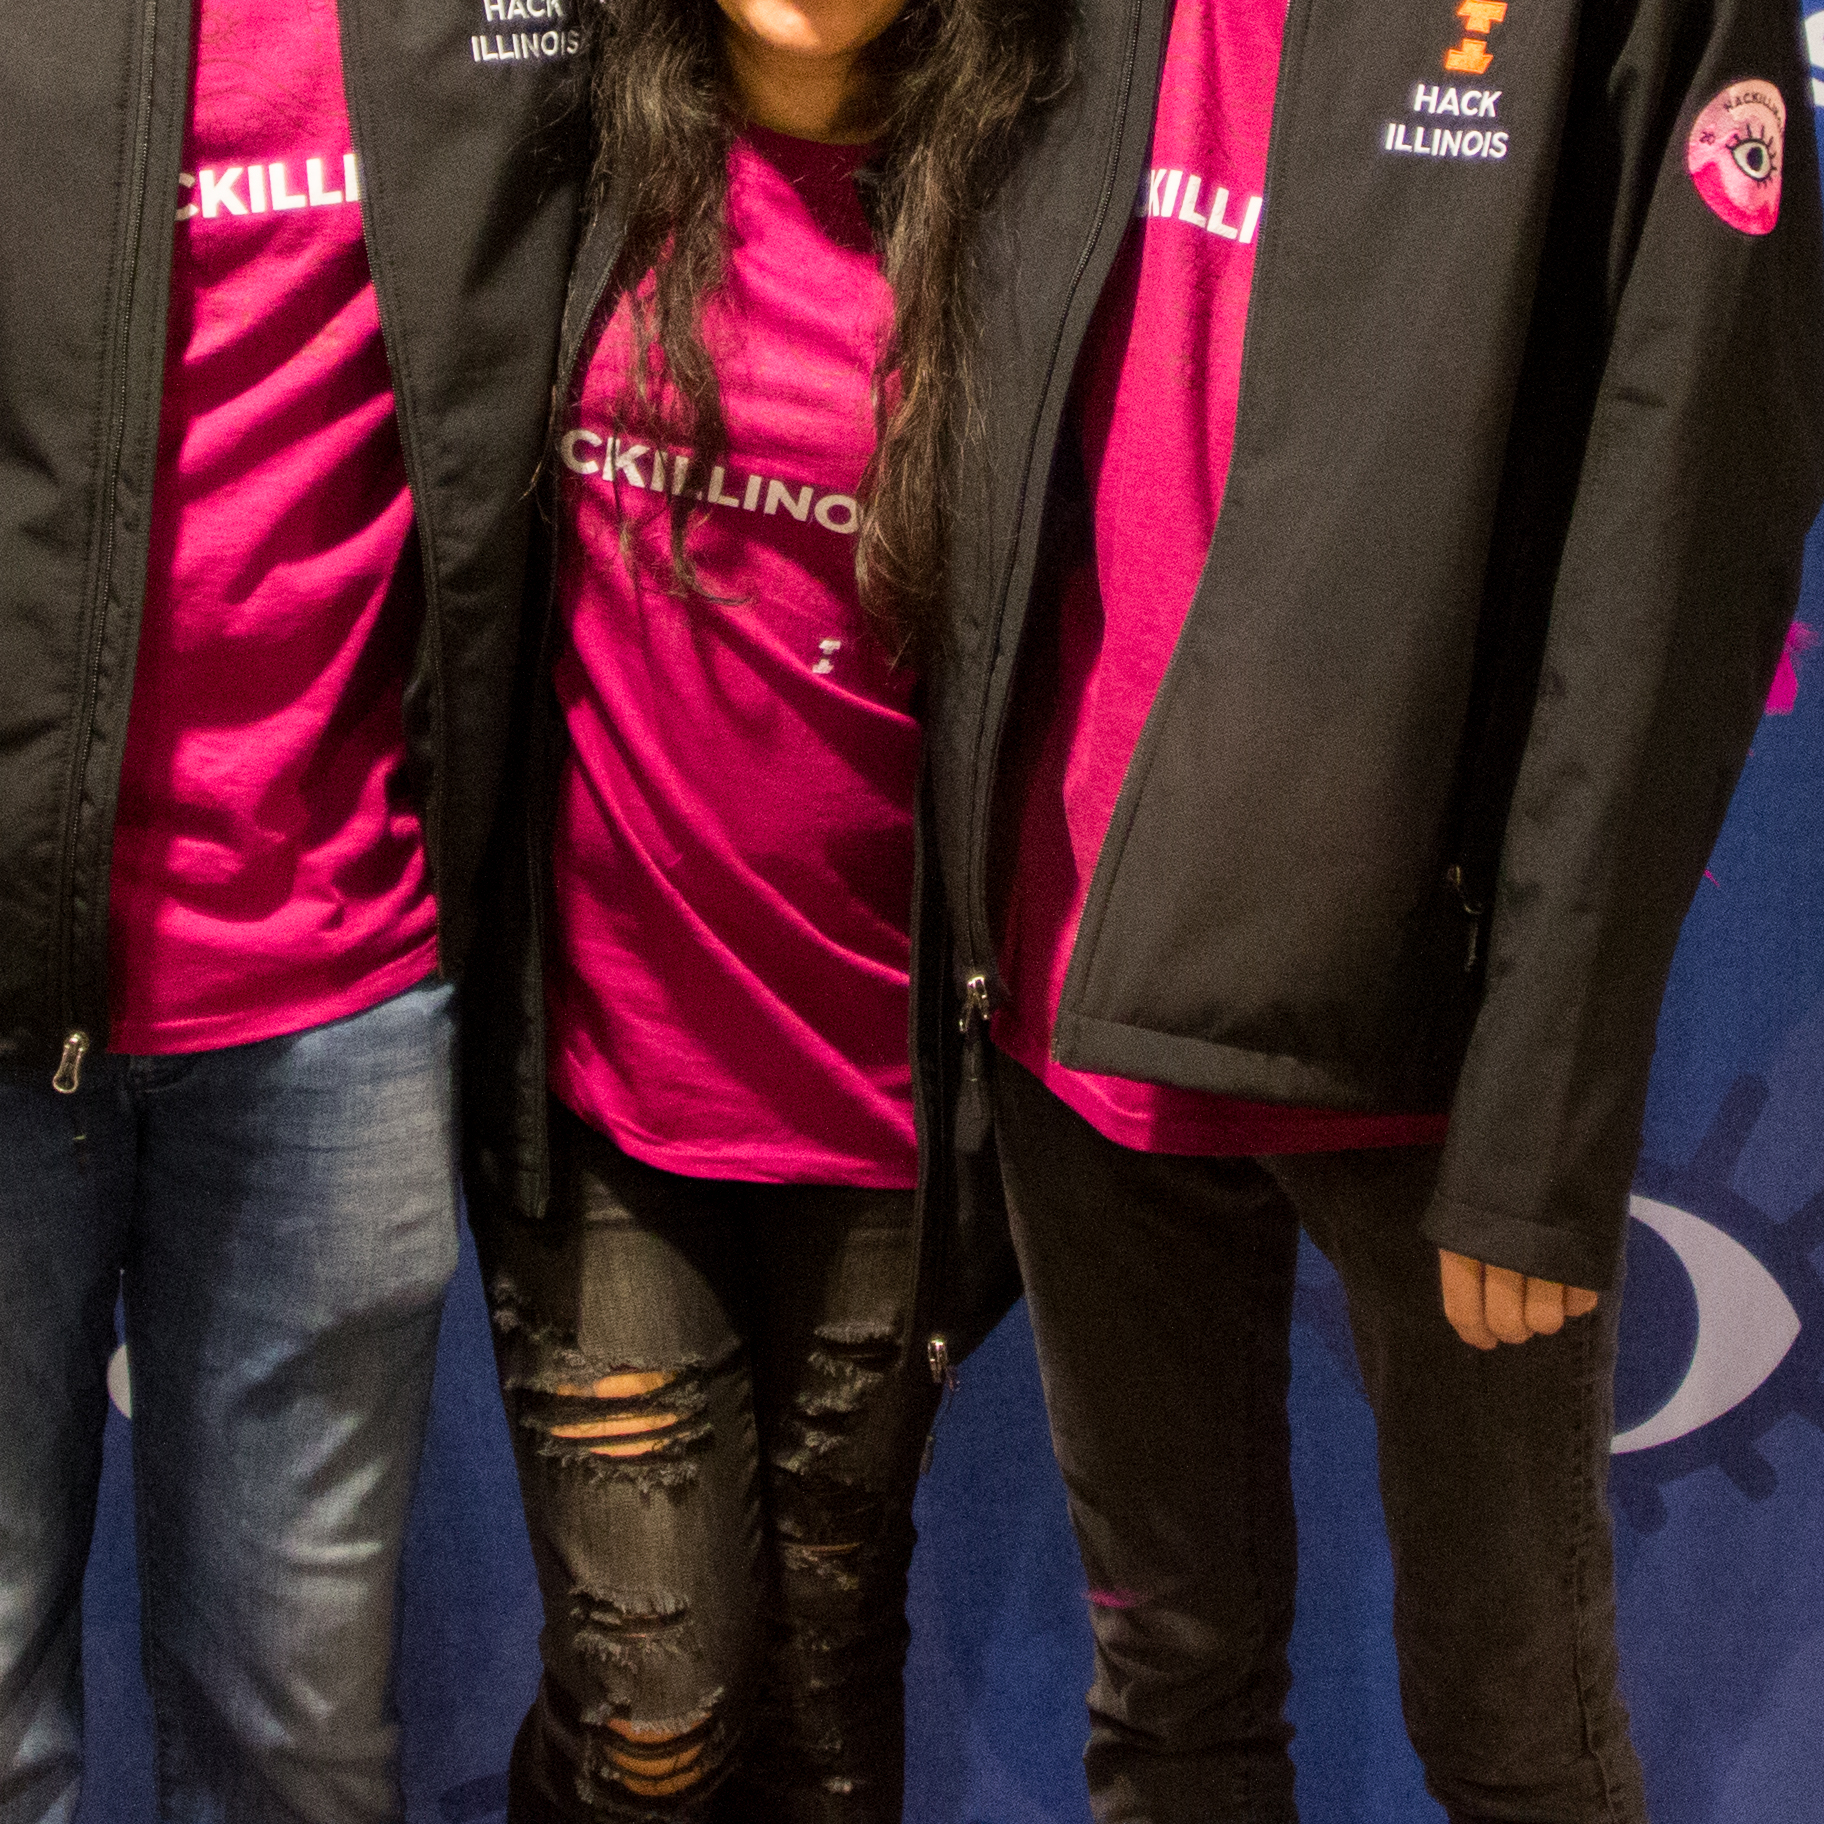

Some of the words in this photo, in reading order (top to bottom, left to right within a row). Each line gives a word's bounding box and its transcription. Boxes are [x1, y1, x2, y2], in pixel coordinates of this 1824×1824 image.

[471, 30, 579, 62] ILLINOIS
[1413, 83, 1502, 117] HACK
[1385, 123, 1509, 159] ILLINOIS
